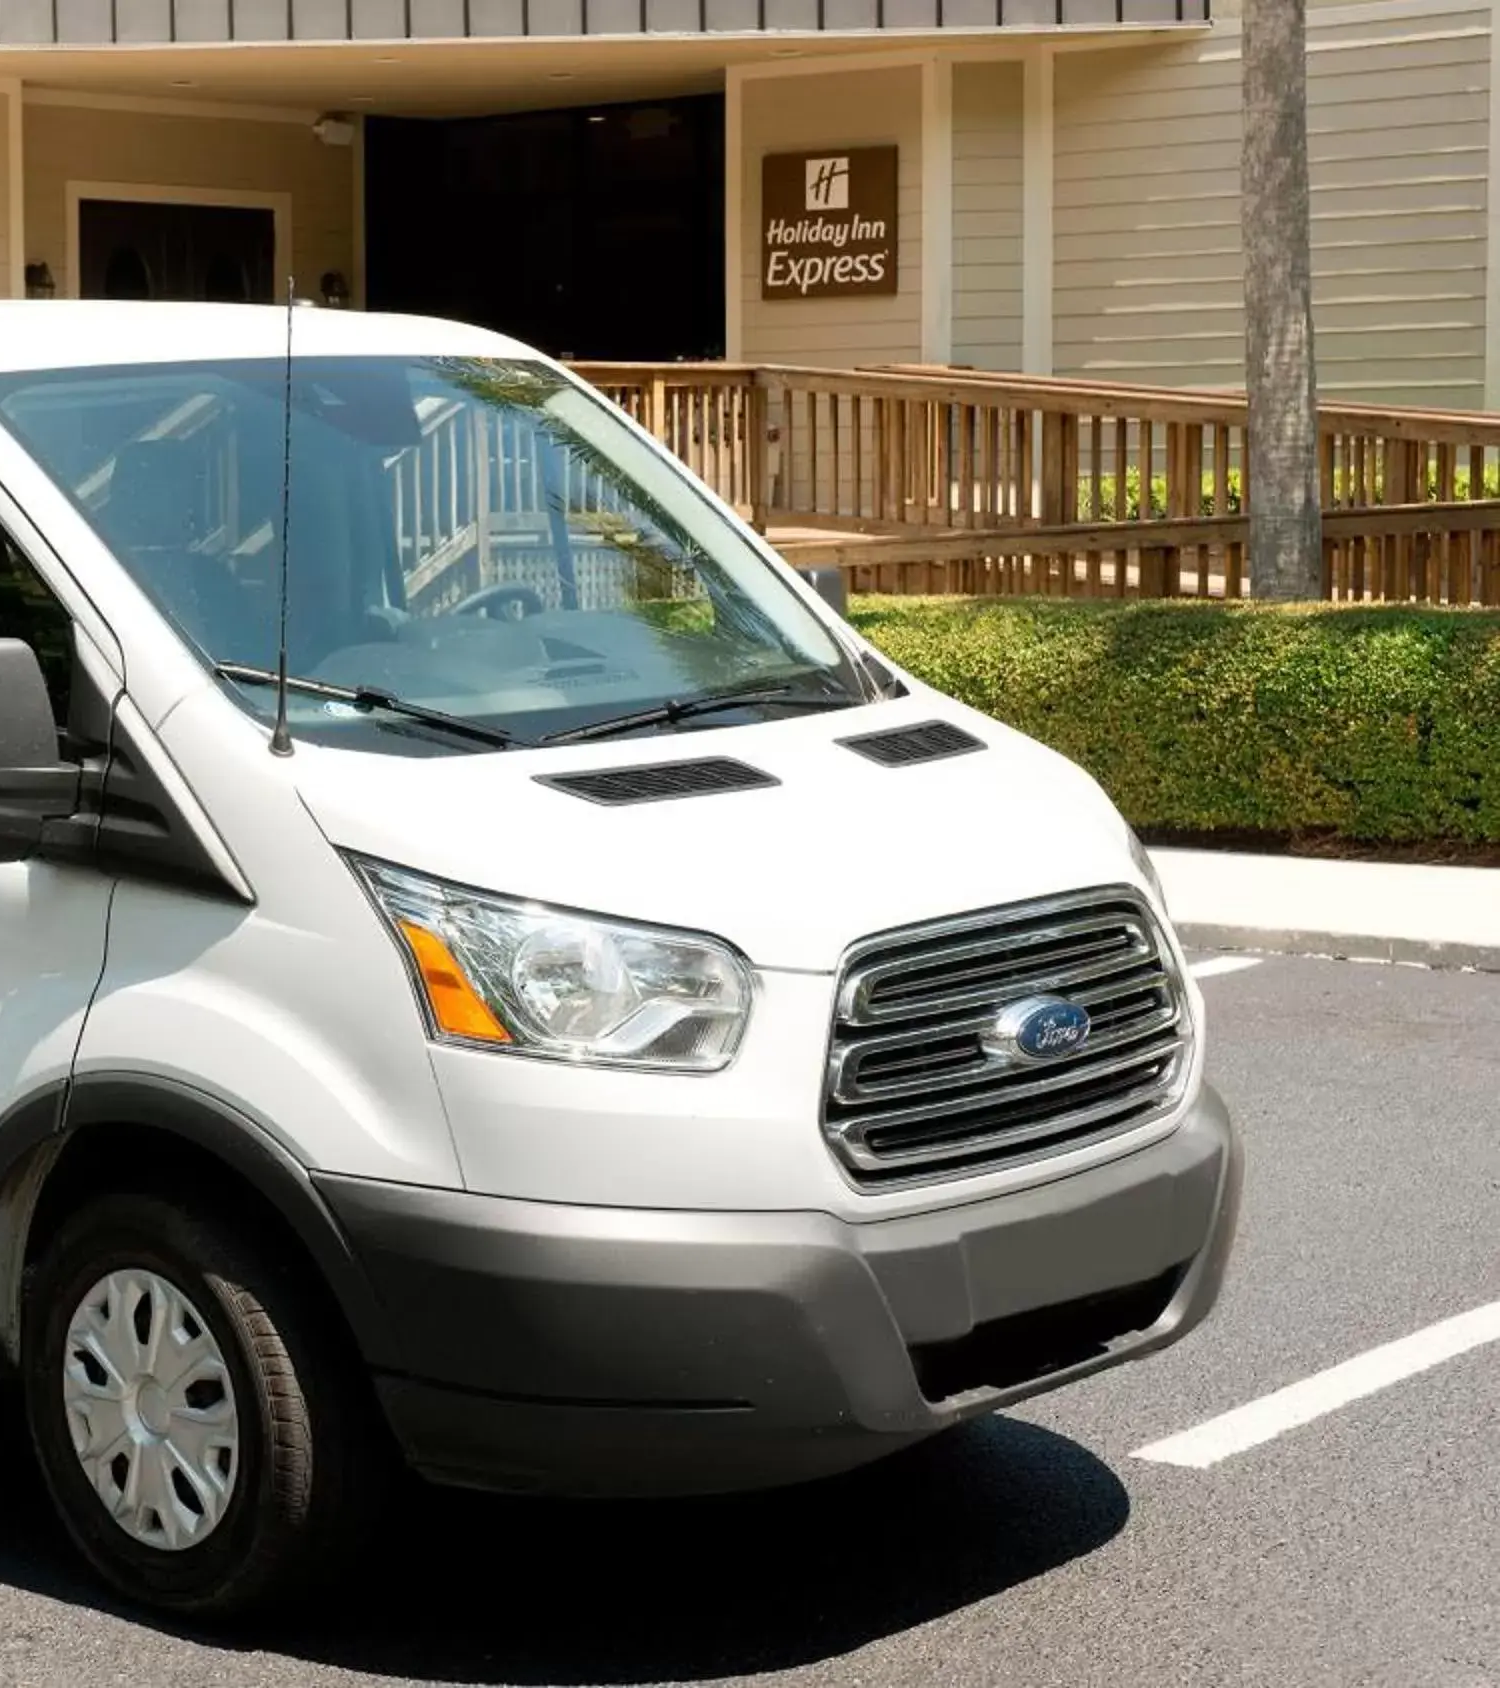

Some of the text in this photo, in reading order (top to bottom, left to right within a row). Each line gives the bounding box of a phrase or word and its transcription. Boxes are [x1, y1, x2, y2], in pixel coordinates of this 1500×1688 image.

[766, 213, 885, 247] Holiday Inn
[767, 251, 885, 295] Express
[1035, 1015, 1079, 1049] Ford
